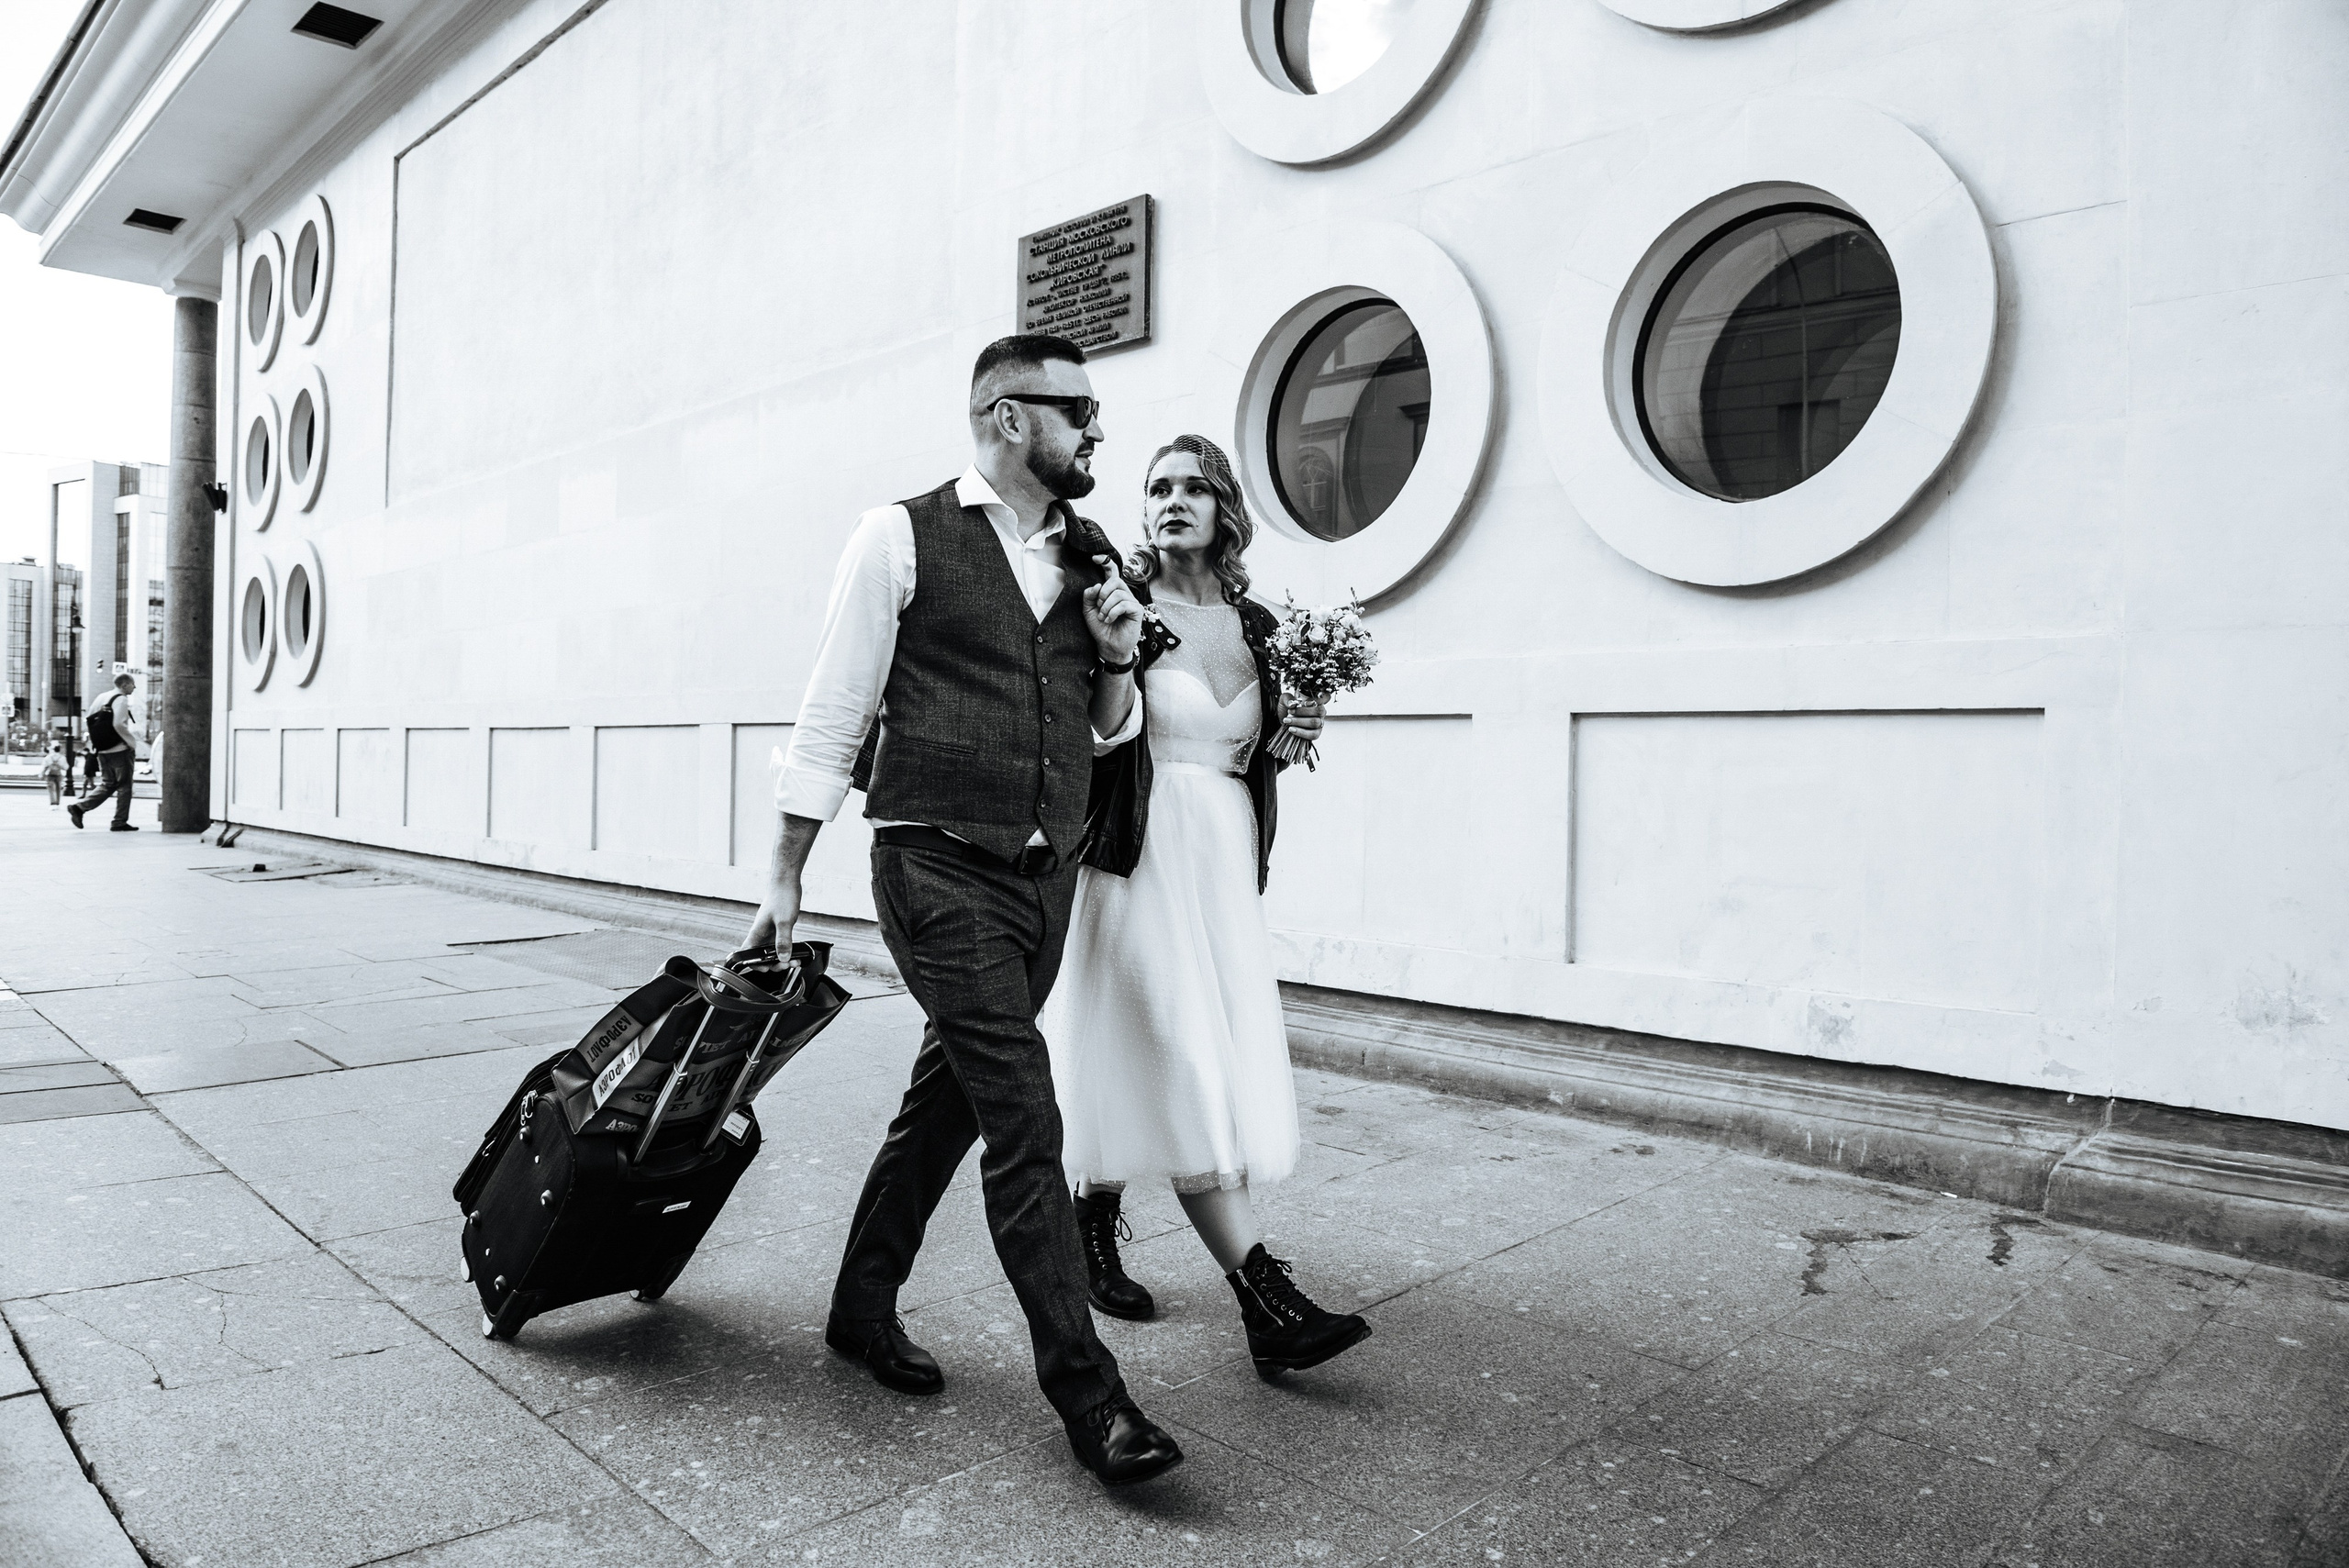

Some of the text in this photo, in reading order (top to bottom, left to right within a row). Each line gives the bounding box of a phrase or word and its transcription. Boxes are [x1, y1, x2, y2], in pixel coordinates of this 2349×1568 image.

[1030, 215, 1131, 256] СТАНЦИЯ МОСКОВСКОГО
[1046, 234, 1113, 264] МЕТРОПОЛИТЕНА
[1027, 241, 1133, 283] СОКОЛЬНИЧЕСКОЙ ЛИНИИ
[1055, 307, 1081, 320] ВЕЛИКОЙ
[1083, 293, 1130, 313] ОТЕЧЕСТВЕННОЙ
[1075, 331, 1119, 349] ОСУДАРСТВОМ
[1088, 323, 1111, 334] АРМИИ
[587, 1015, 632, 1063] АЭРОФЛОТ
[631, 1093, 695, 1113] SOET
[606, 1118, 640, 1133] АЭРО
